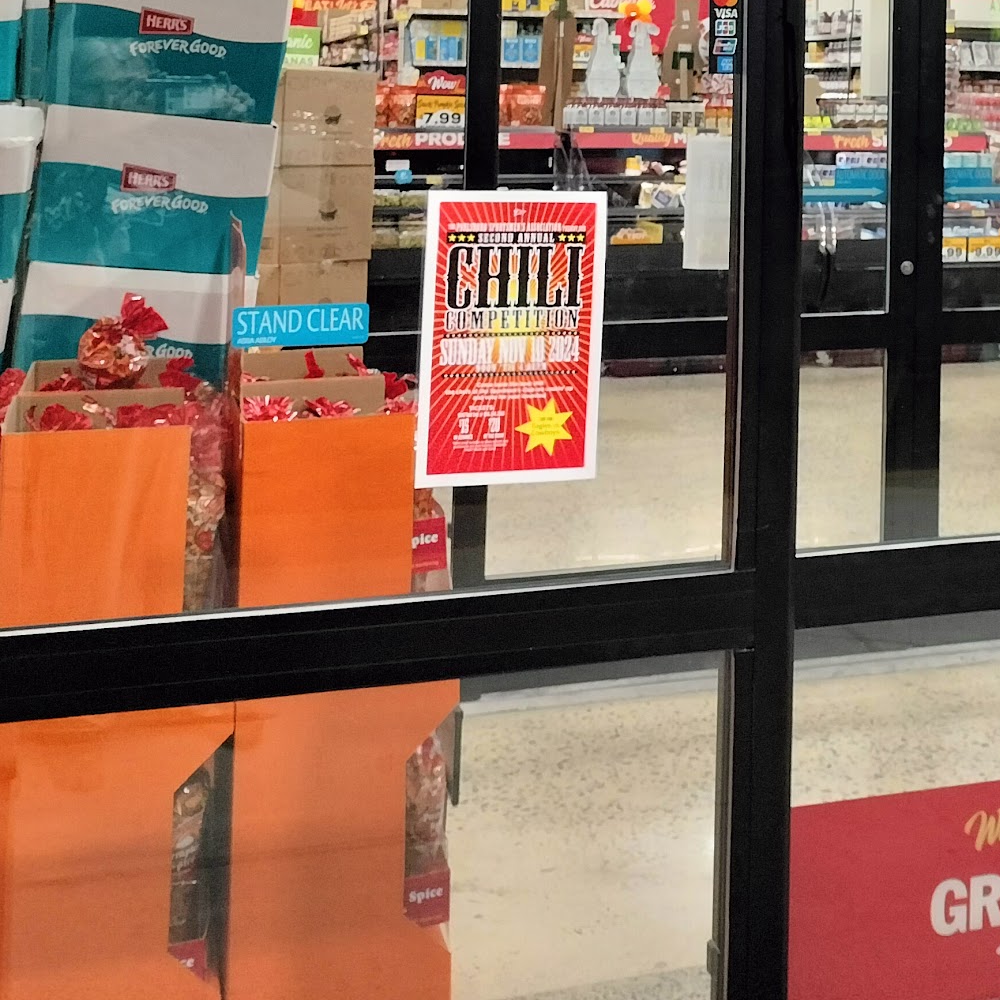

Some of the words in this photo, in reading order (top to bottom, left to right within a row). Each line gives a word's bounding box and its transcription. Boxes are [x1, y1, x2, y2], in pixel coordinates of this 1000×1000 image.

[714, 8, 738, 19] VISA
[423, 112, 461, 124] 7.99
[477, 233, 514, 243] SECOND
[517, 233, 555, 243] ANNUAL
[446, 245, 585, 309] CHILI
[237, 310, 302, 335] STAND
[307, 307, 364, 332] CLEAR
[445, 309, 578, 331] COMPETITION
[440, 338, 492, 365] SUNDAY
[497, 336, 527, 364] NOV
[548, 336, 579, 362] 2024
[411, 533, 439, 549] pice
[408, 886, 444, 903] Spice
